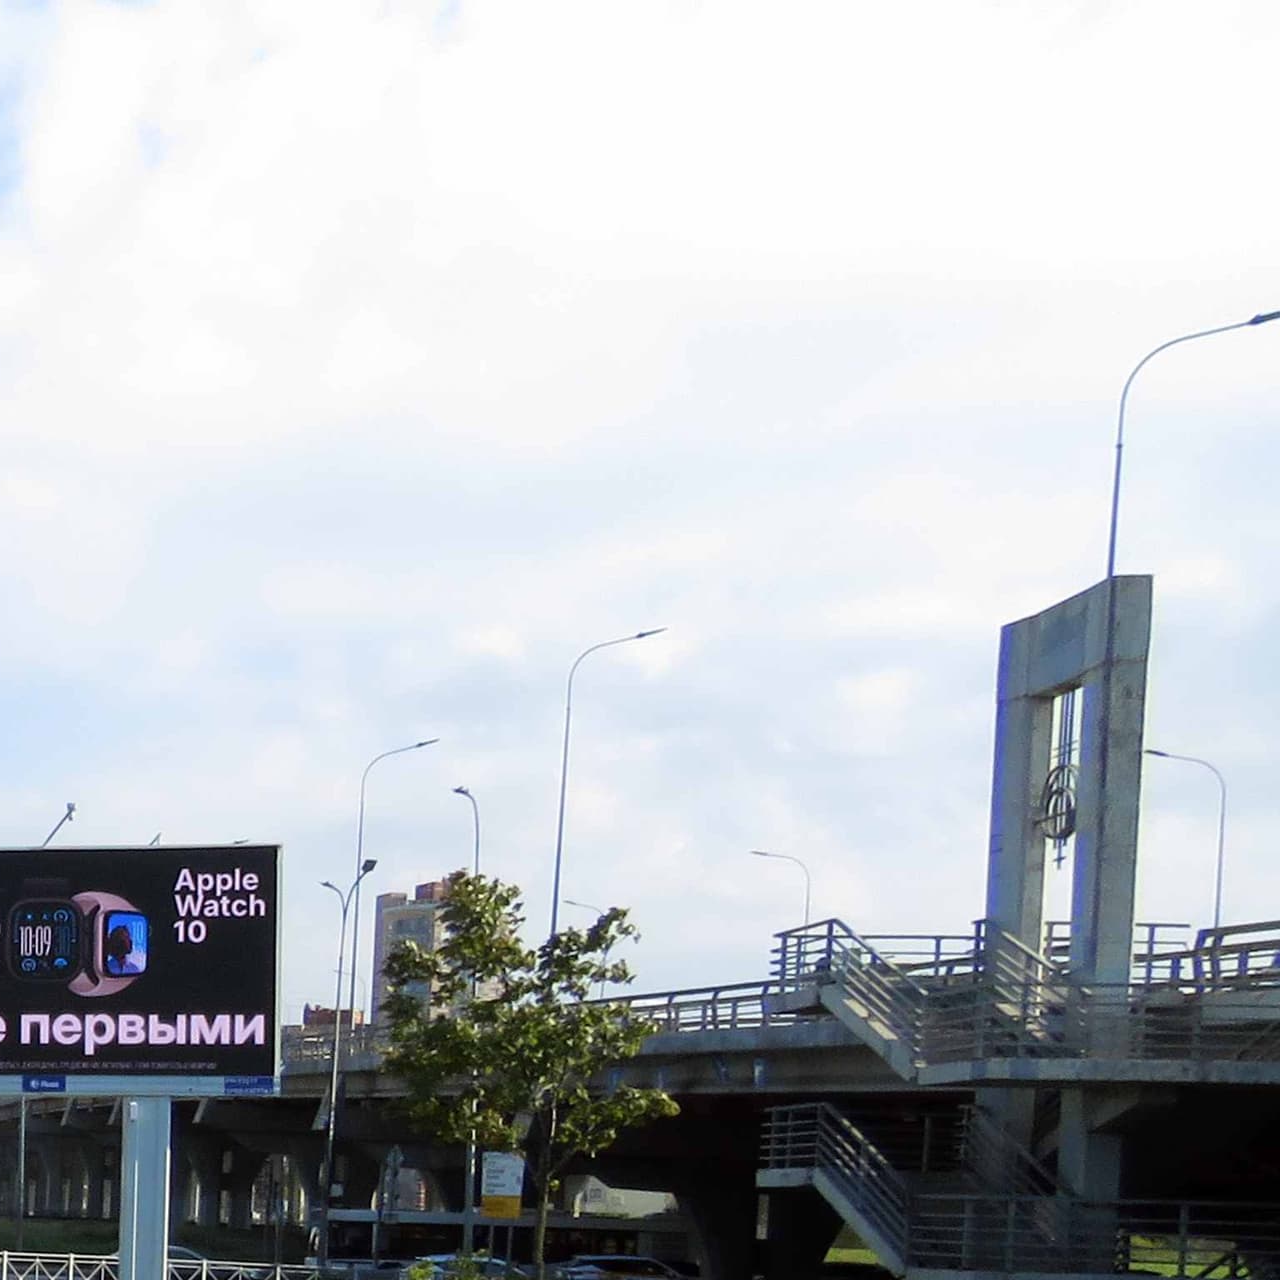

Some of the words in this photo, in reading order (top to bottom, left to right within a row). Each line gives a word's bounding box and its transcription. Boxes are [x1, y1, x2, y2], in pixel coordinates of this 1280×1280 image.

[174, 868, 259, 897] Apple
[174, 893, 267, 918] Watch
[19, 925, 52, 957] 10:09
[173, 920, 207, 943] 10
[20, 1013, 266, 1056] первыми
